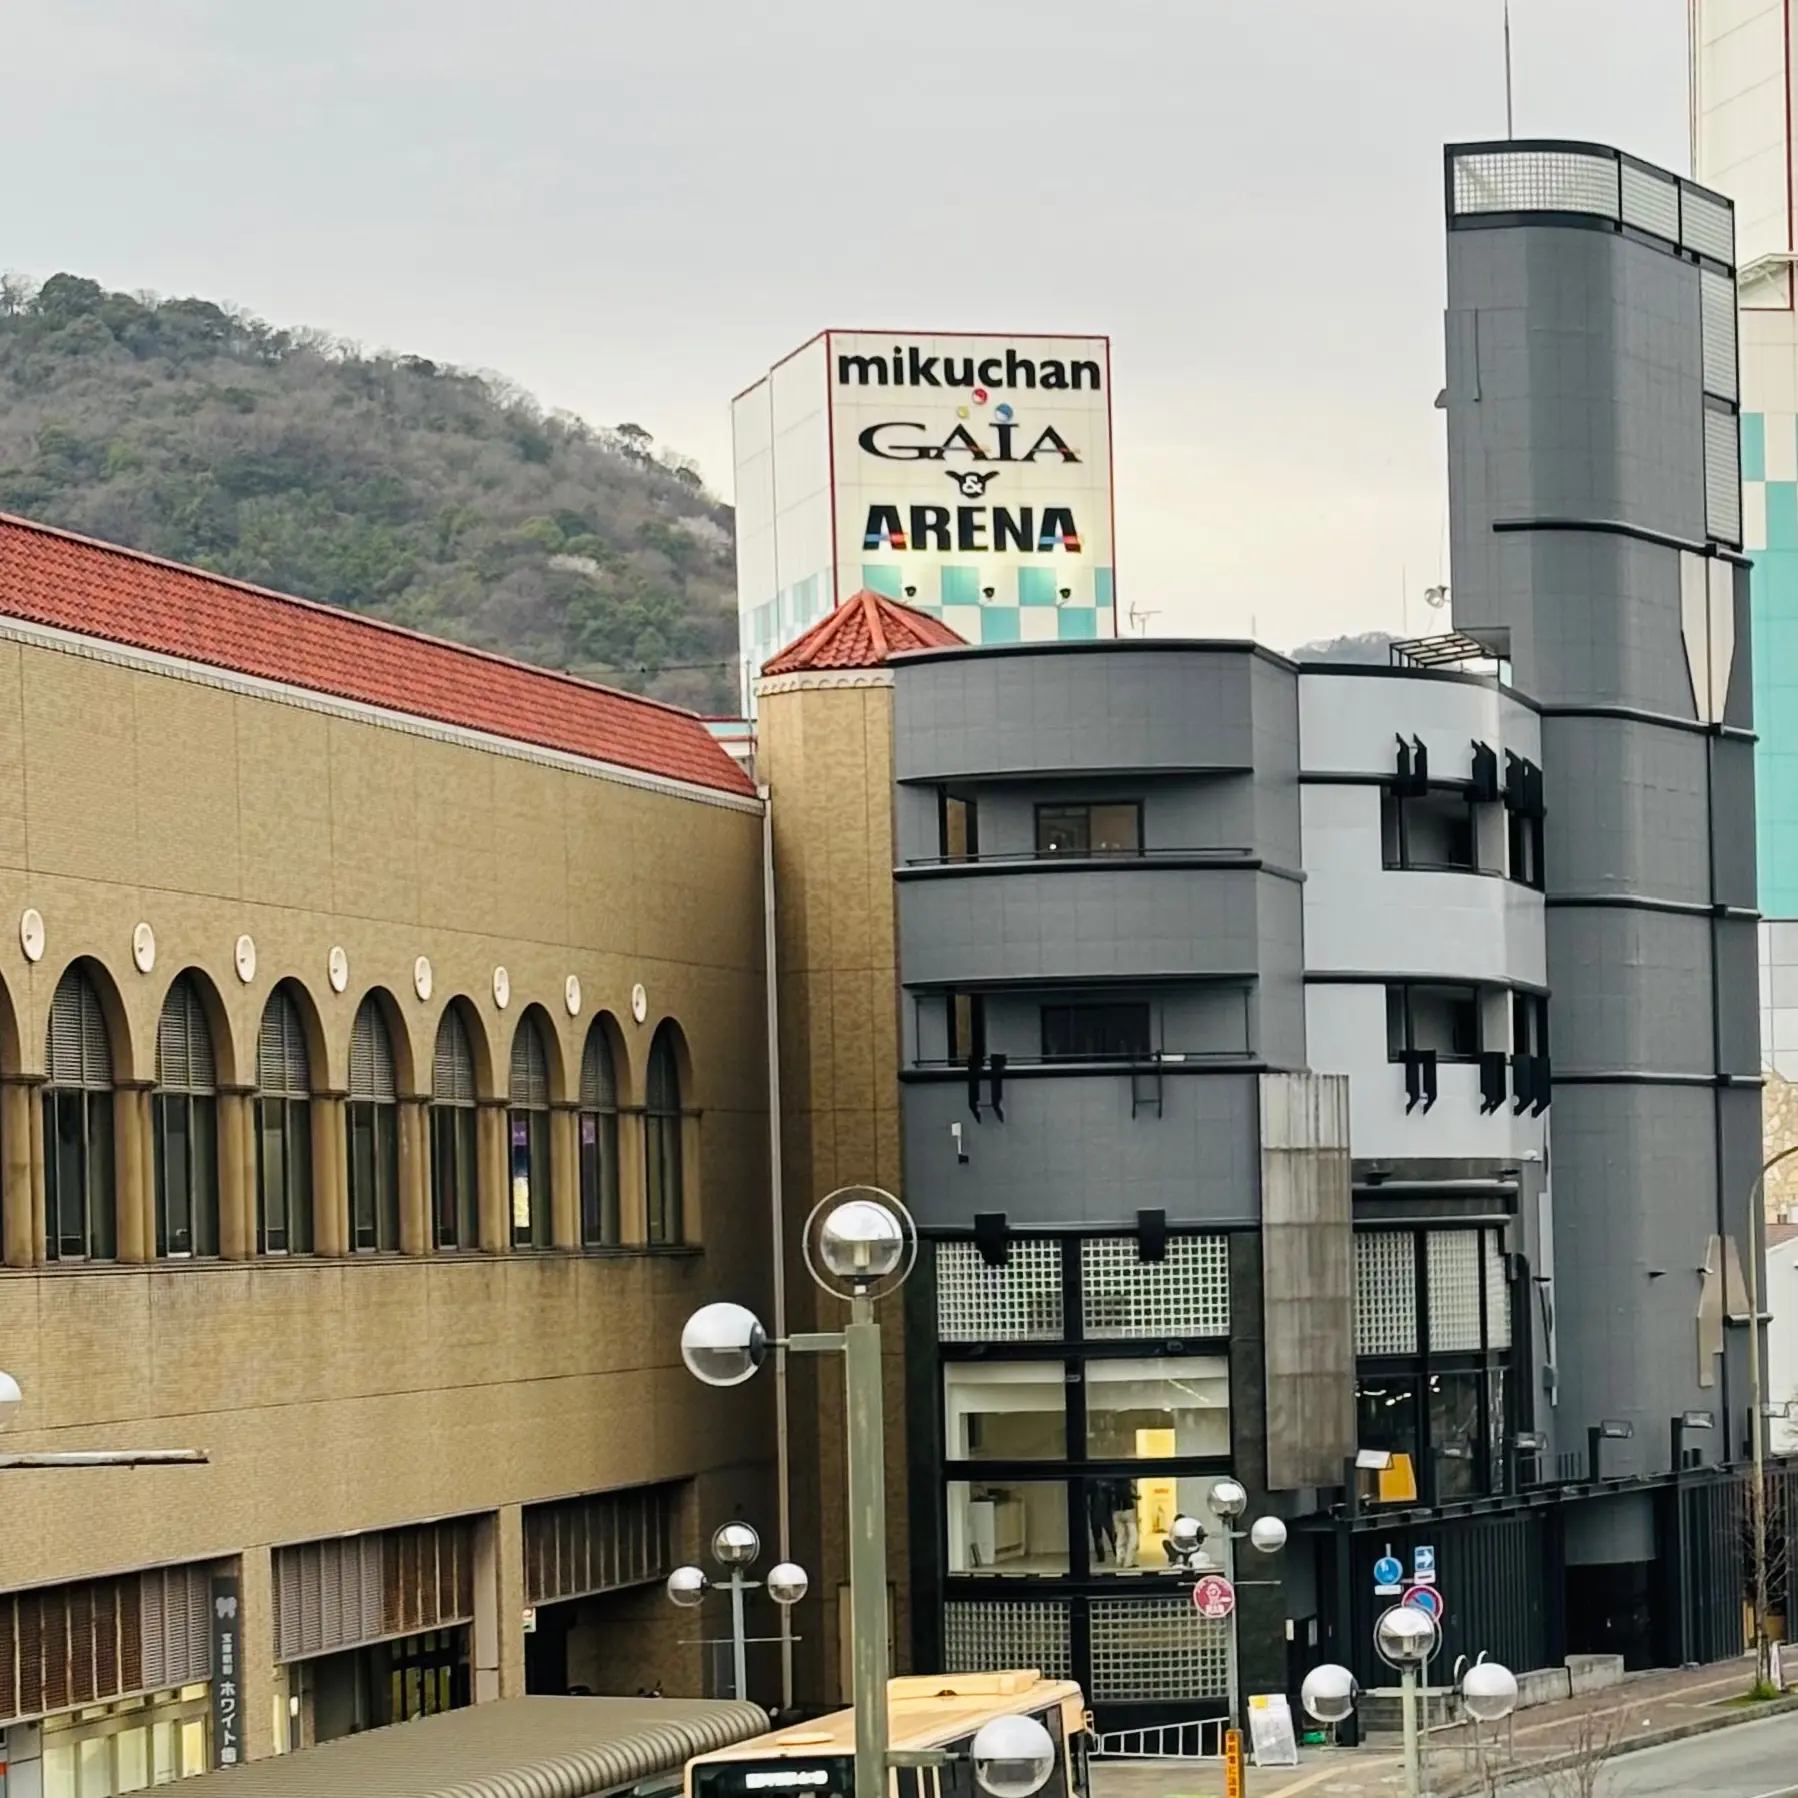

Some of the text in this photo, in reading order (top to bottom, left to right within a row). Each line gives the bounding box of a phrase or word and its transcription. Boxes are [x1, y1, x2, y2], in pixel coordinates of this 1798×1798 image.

[838, 346, 1101, 390] mikuchan
[858, 422, 1083, 464] GAIA
[961, 473, 985, 496] &
[862, 504, 1082, 553] ARENA
[219, 1681, 238, 1768] ホワイト歯
